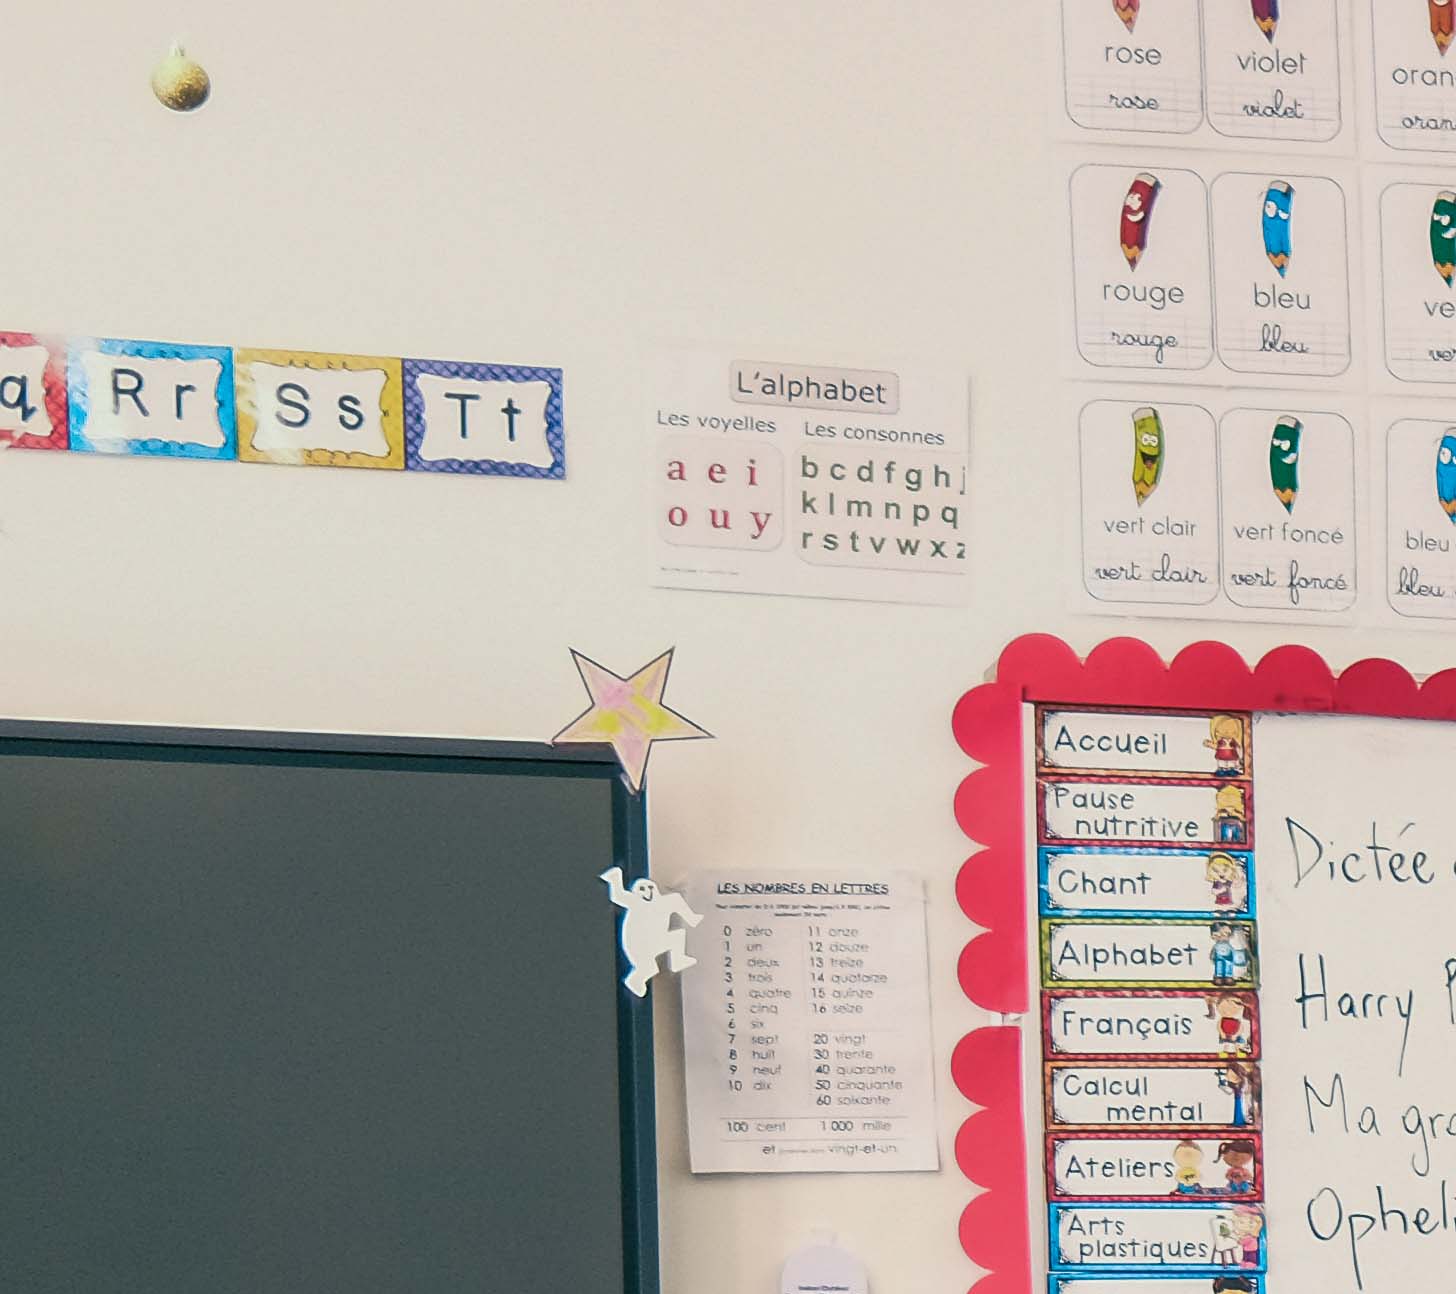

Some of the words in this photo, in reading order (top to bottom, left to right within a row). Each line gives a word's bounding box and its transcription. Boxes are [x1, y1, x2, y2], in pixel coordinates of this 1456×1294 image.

[1106, 46, 1161, 65] rose
[1237, 49, 1306, 74] violet
[1103, 284, 1184, 310] rouge
[1254, 284, 1310, 310] bleu
[738, 372, 886, 404] L'alphabet
[658, 410, 689, 427] Les
[698, 412, 777, 436] voyelles
[805, 422, 836, 438] Les
[844, 423, 945, 447] consonnes
[1104, 517, 1144, 534] vert
[1152, 516, 1196, 536] clair
[1234, 525, 1272, 540] vert
[1282, 522, 1343, 544] foncé
[1406, 531, 1444, 552] bleu
[1054, 726, 1166, 754] Accueil
[1054, 787, 1135, 809] Pause
[1075, 816, 1199, 840] nutritive
[1286, 817, 1434, 887] Dictée
[718, 883, 739, 894] LES
[745, 883, 805, 894] NOMBRES
[812, 884, 829, 894] EN
[834, 884, 888, 894] LETTRES
[1058, 870, 1151, 894] Chant
[1057, 942, 1197, 968] Alphabet
[1063, 1011, 1192, 1040] Français
[1295, 953, 1413, 1077] Harry
[1063, 1074, 1147, 1096] Calcul
[1107, 1102, 1202, 1122] mental
[1304, 1073, 1380, 1135] Ma
[1065, 1155, 1174, 1178] Ateliers
[1068, 1214, 1124, 1235] Arts
[1079, 1236, 1208, 1265] plastiques
